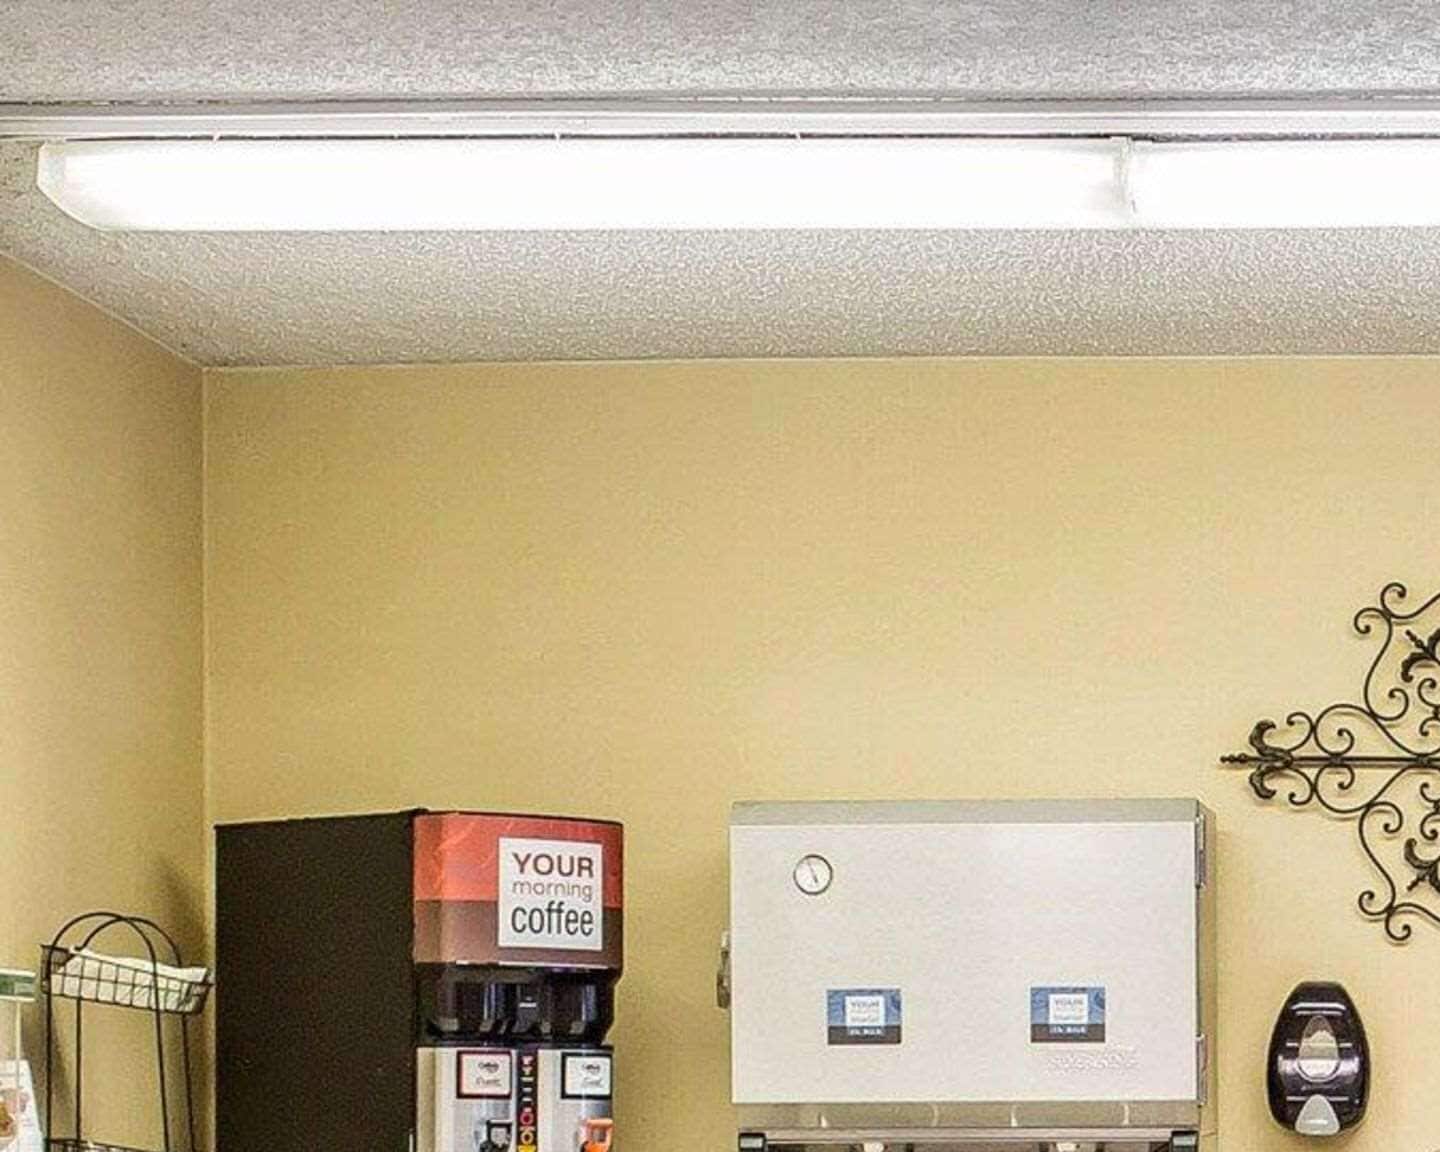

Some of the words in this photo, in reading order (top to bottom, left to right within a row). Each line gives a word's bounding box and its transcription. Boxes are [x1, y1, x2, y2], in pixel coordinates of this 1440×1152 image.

[511, 852, 594, 878] YOUR
[511, 880, 593, 903] morning
[511, 900, 594, 937] coffee
